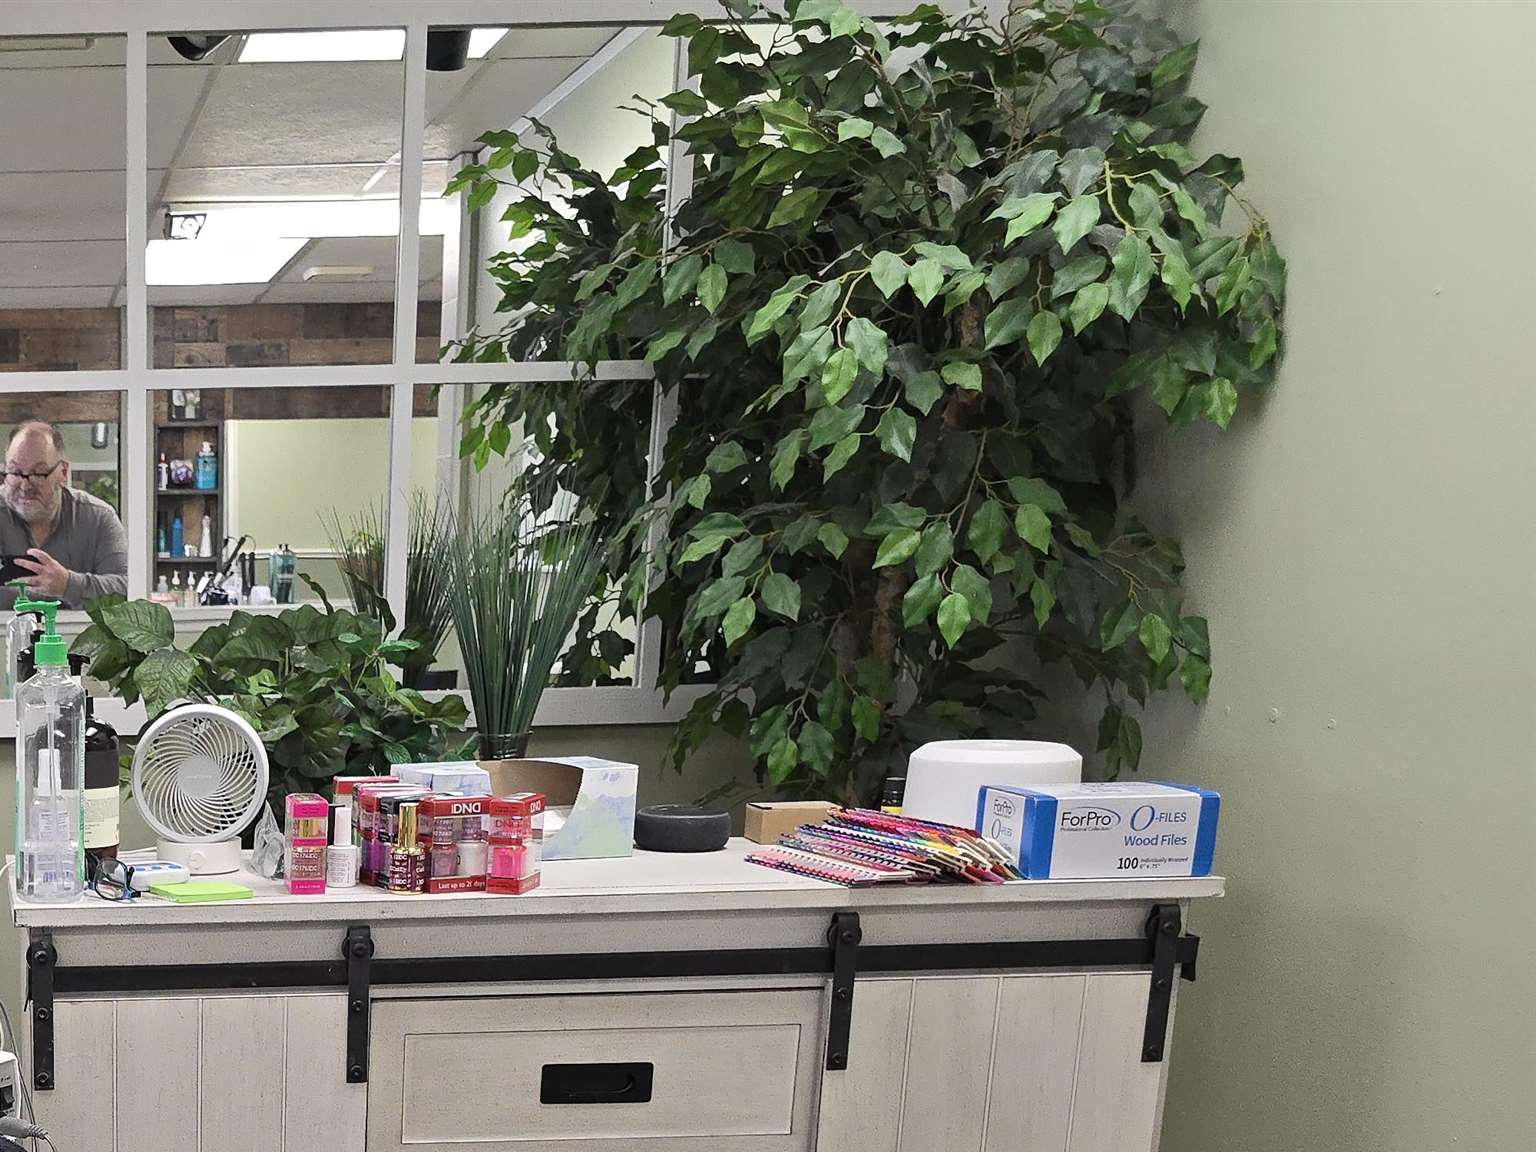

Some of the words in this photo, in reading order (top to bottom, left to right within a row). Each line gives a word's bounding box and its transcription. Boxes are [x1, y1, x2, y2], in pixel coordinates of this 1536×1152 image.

[452, 803, 481, 813] DND
[1061, 811, 1112, 826] ForPro
[1124, 834, 1159, 847] Wood
[1161, 834, 1188, 846] Files
[1117, 857, 1139, 870] 100
